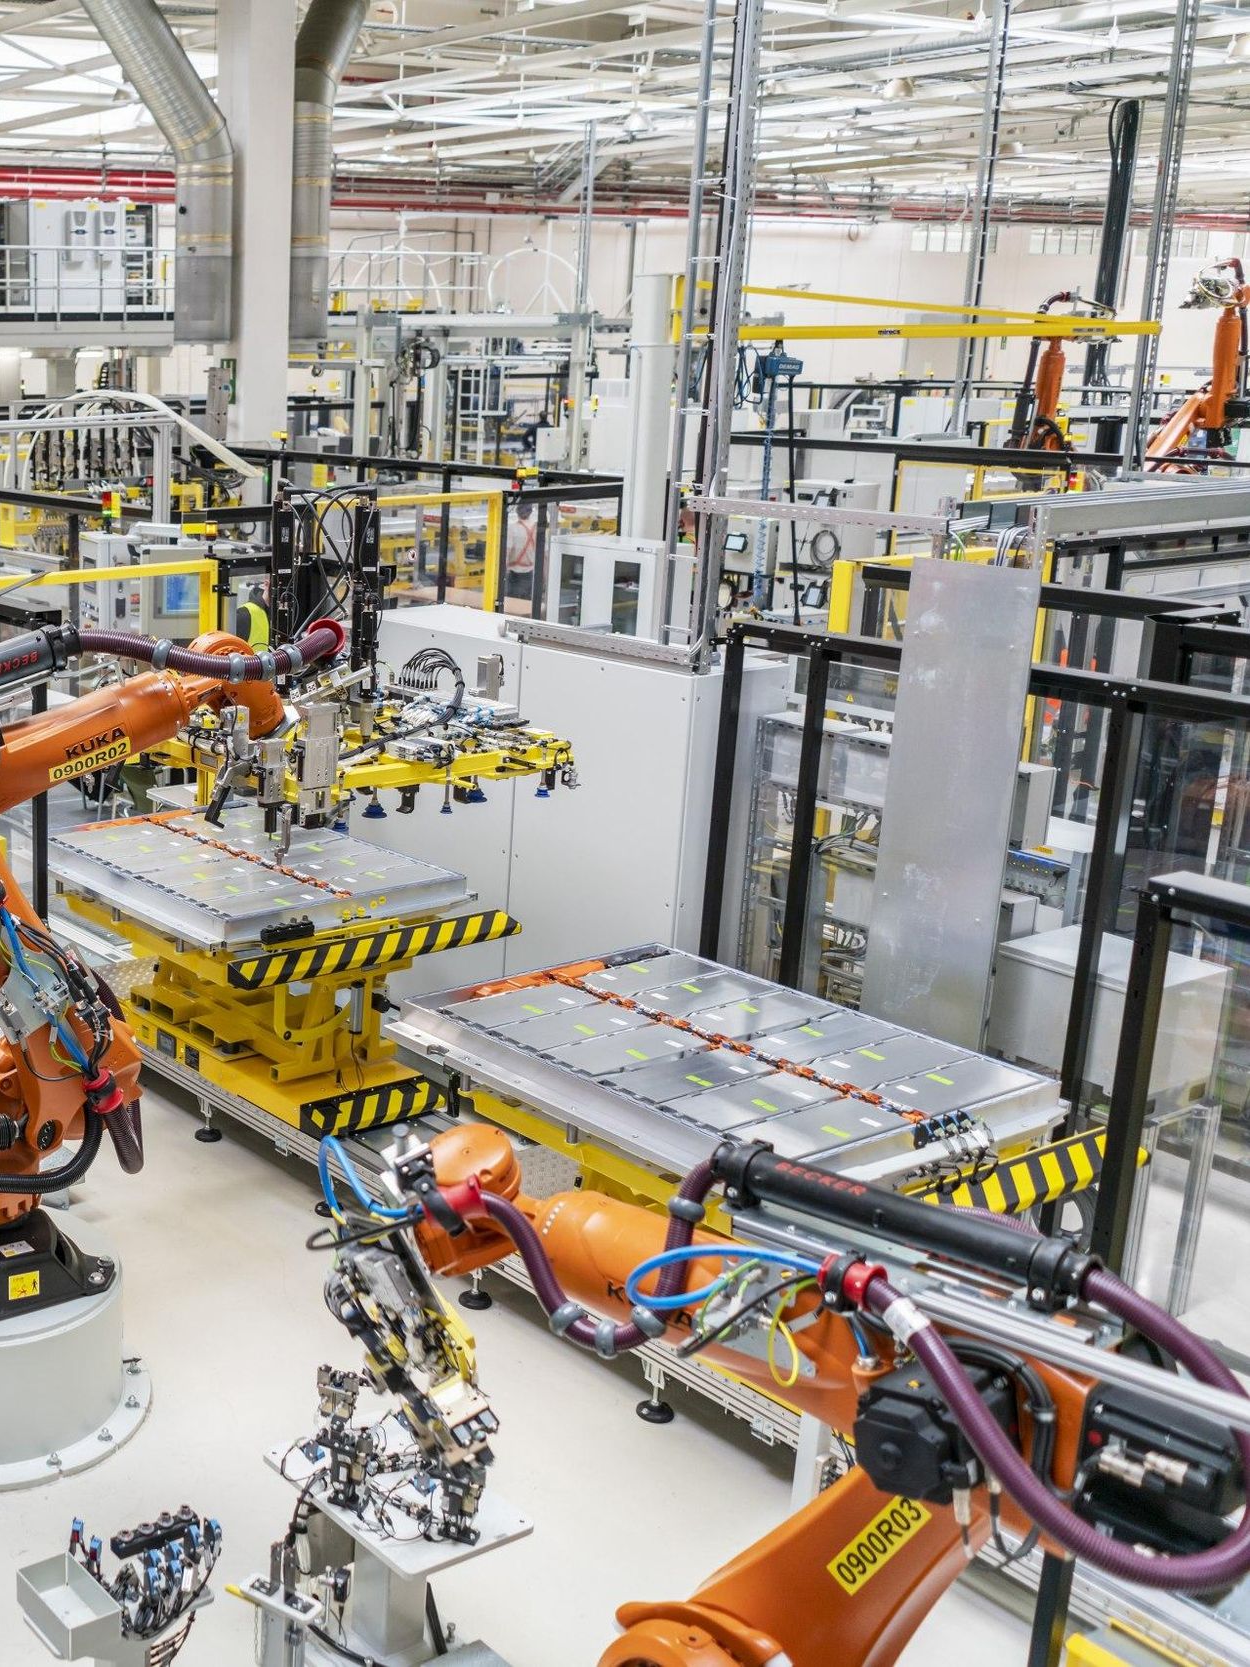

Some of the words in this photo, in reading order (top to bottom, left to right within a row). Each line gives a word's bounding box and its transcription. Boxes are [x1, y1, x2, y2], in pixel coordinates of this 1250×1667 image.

[53, 742, 127, 780] 0900R02
[65, 727, 126, 759] KUKA
[775, 1161, 868, 1196] BECKER
[836, 1497, 922, 1585] 0900R03
